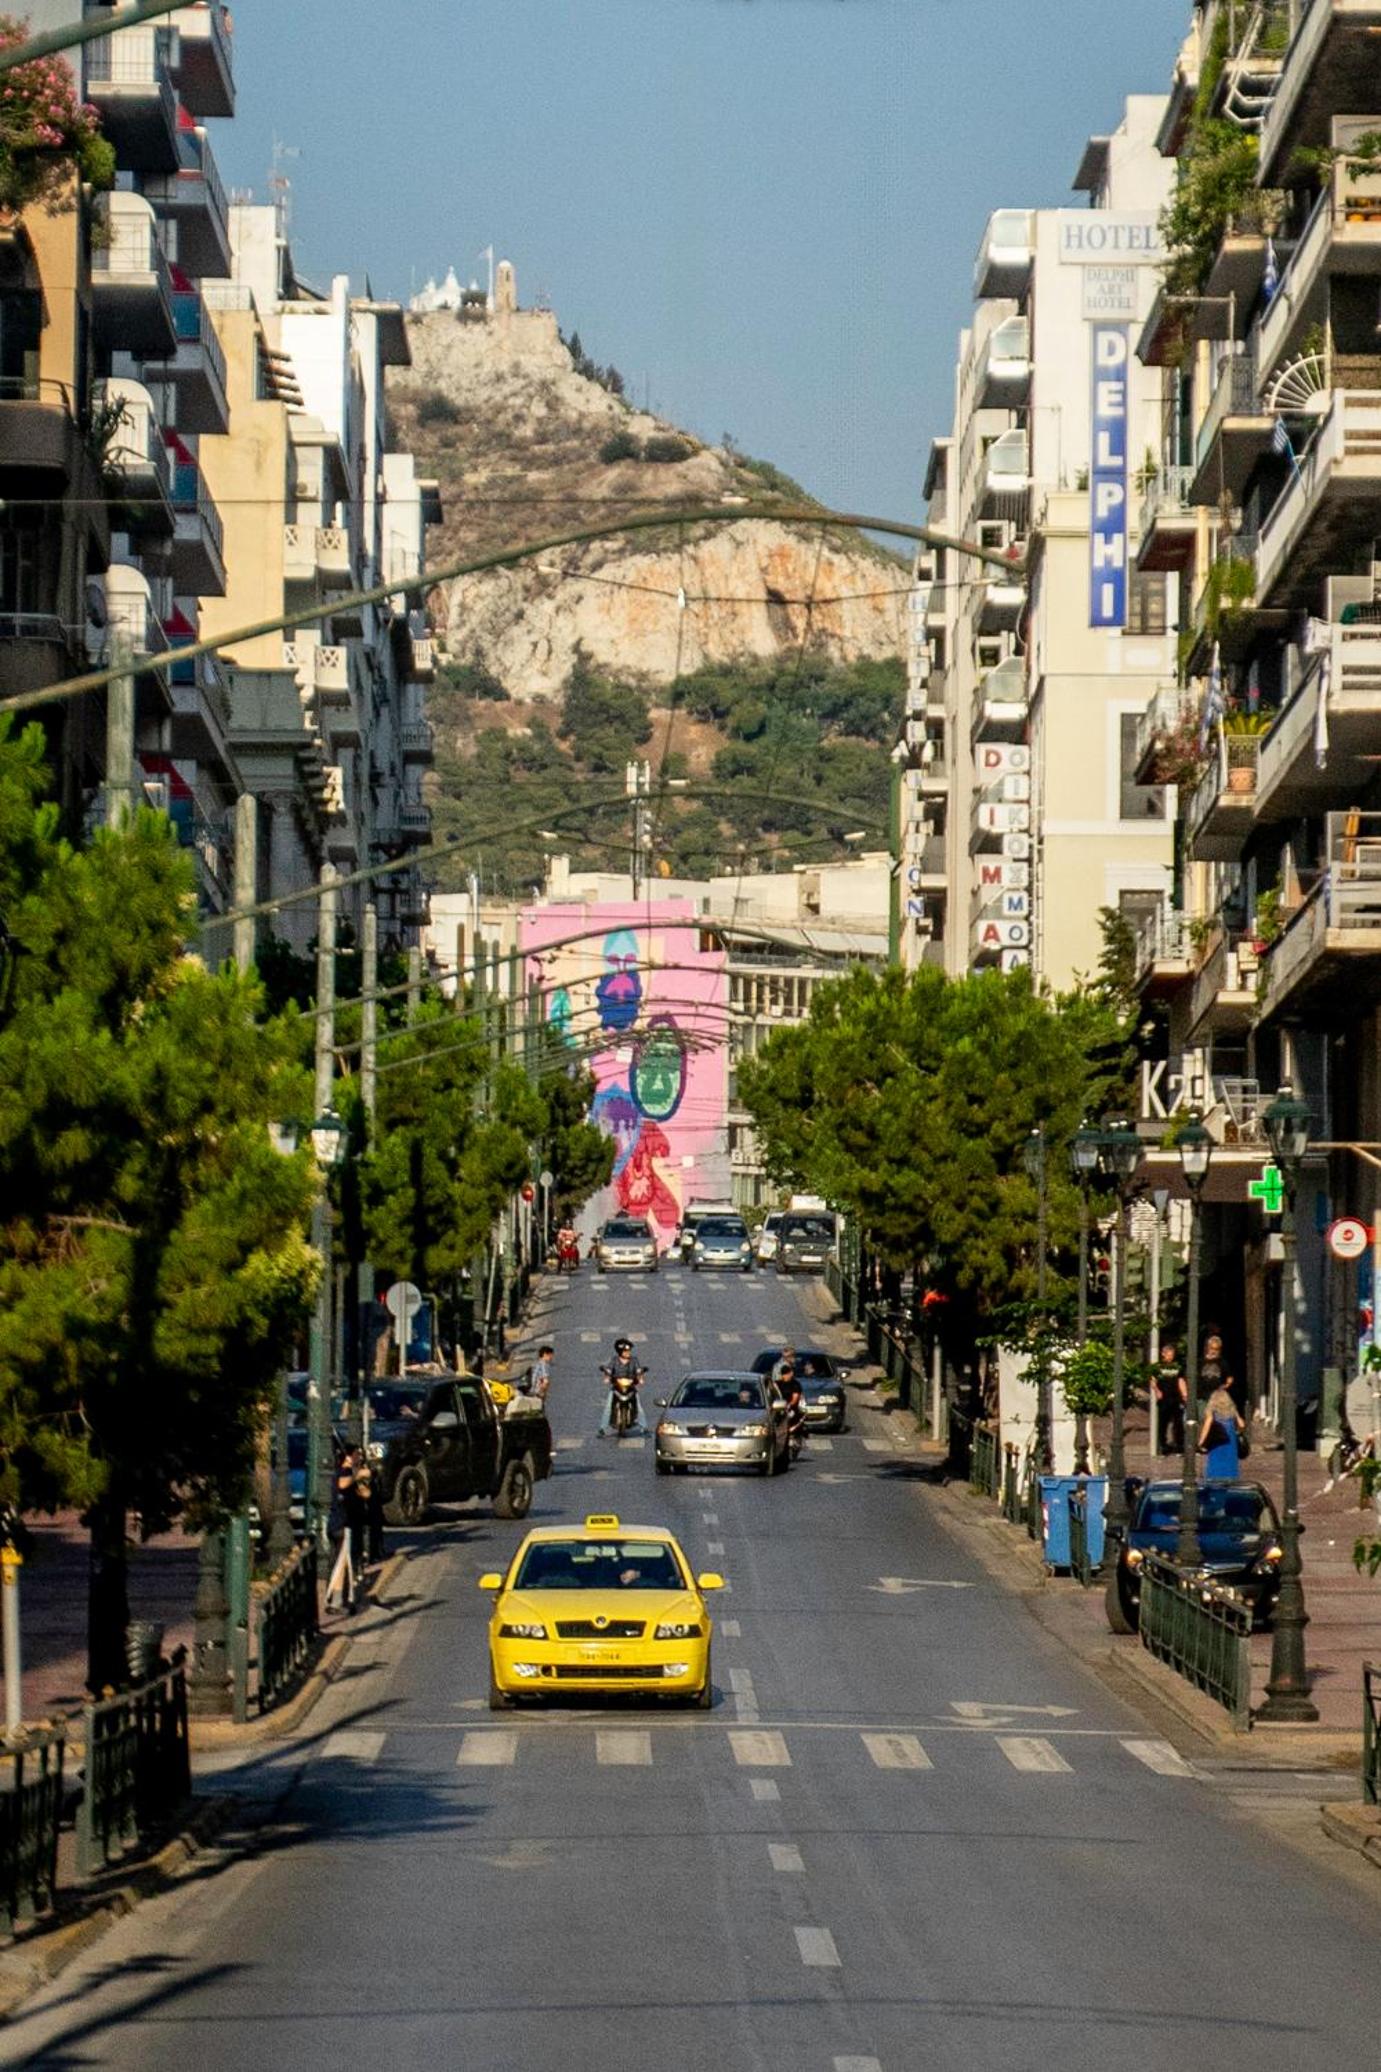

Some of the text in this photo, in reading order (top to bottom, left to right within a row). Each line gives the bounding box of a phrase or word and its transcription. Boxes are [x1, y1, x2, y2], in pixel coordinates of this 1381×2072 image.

[1065, 224, 1158, 250] HOTEL
[1087, 268, 1135, 283] DELPHI
[1098, 284, 1123, 296] ART
[1087, 296, 1132, 309] HOTEL
[1093, 331, 1126, 619] DELPHI
